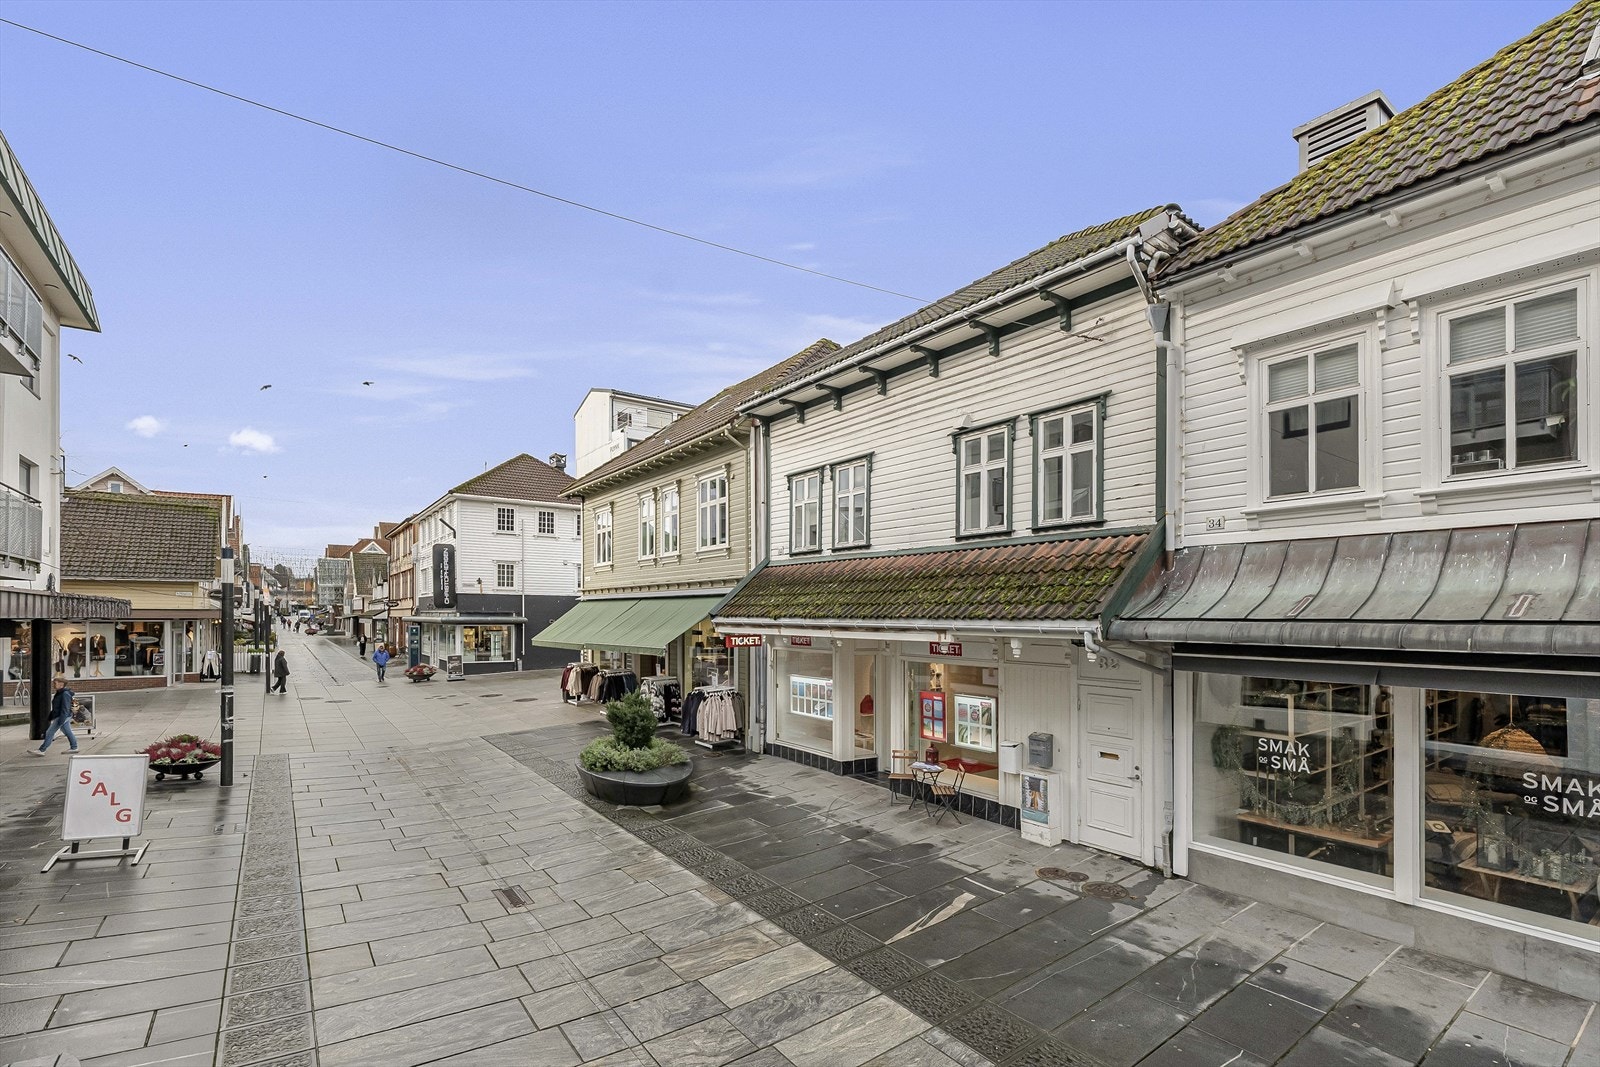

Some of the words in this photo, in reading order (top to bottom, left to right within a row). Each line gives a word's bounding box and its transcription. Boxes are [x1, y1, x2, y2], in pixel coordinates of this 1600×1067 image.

[1208, 518, 1222, 529] 34
[731, 636, 760, 646] TICKET
[792, 636, 811, 646] TICKET
[931, 643, 960, 655] TICET
[1258, 738, 1310, 758] SMAK
[1271, 756, 1311, 774] SMÅ
[1522, 772, 1600, 797] SMAK
[79, 770, 132, 823] SALG
[1523, 795, 1538, 805] OG
[1543, 795, 1600, 818] SMÅ
